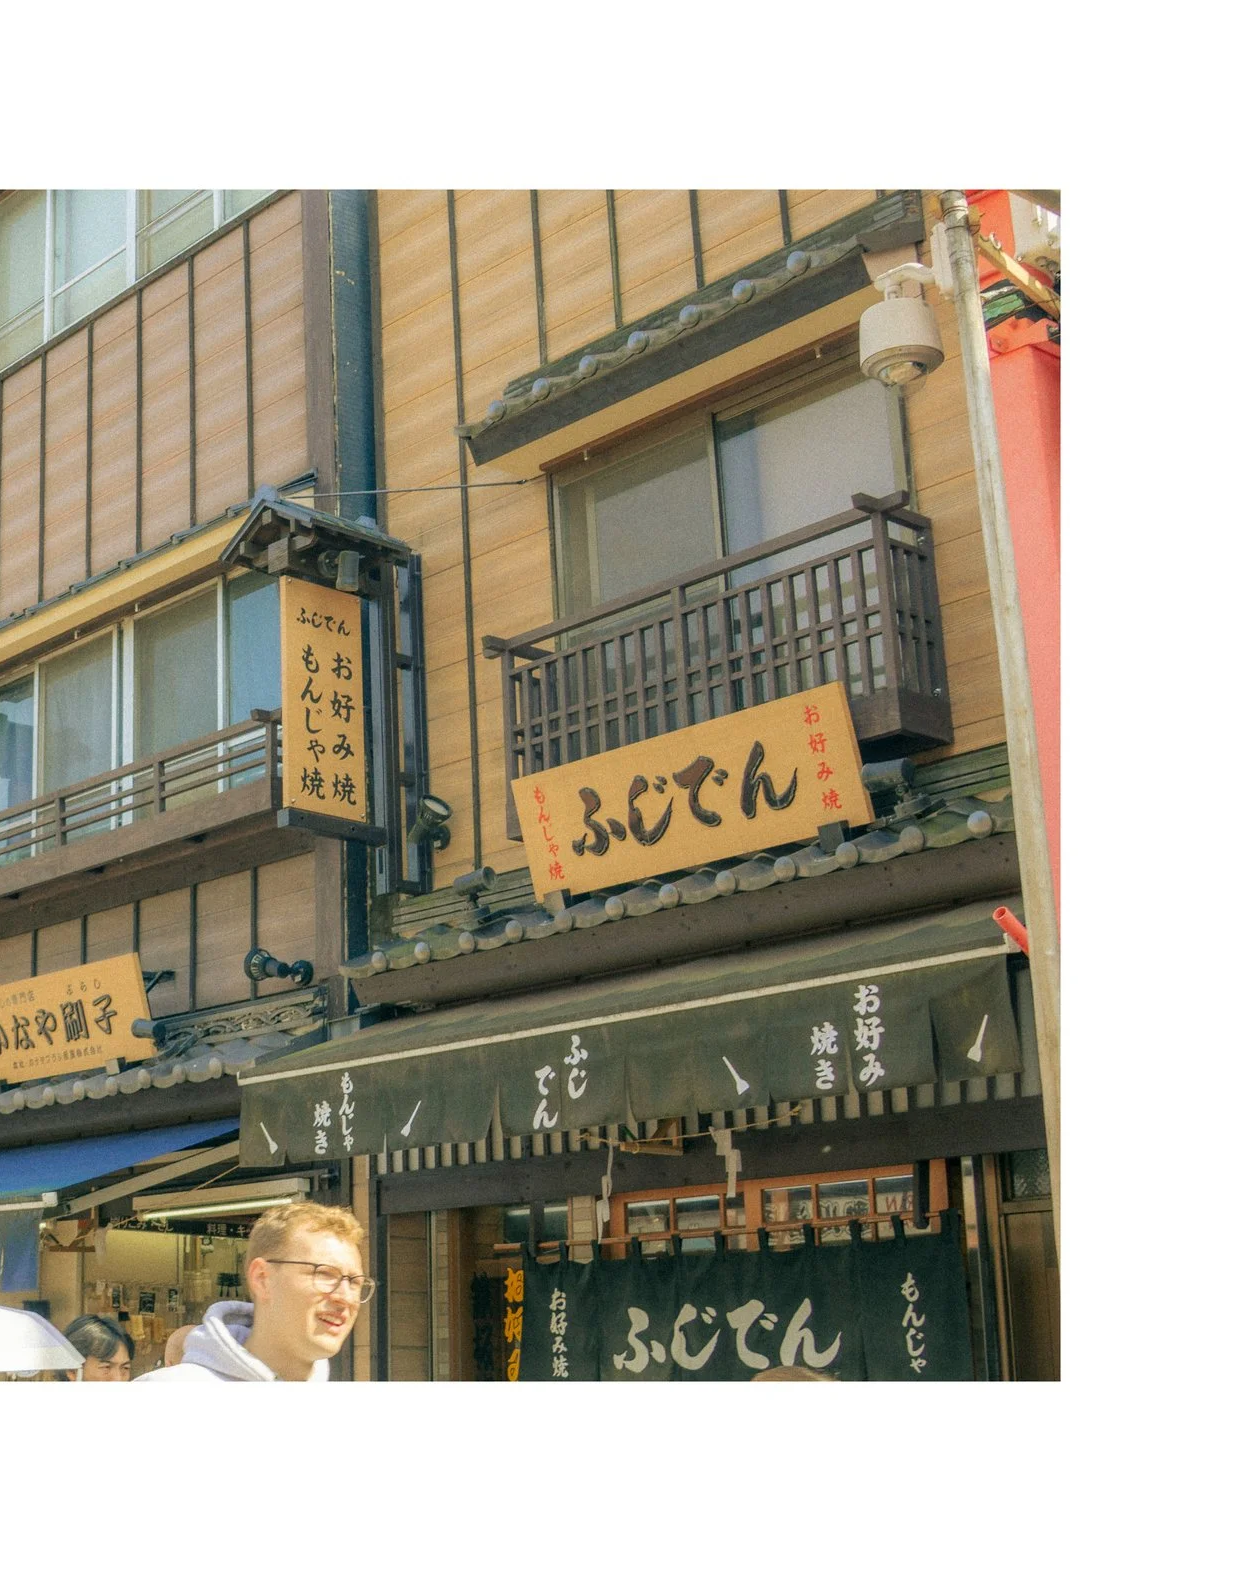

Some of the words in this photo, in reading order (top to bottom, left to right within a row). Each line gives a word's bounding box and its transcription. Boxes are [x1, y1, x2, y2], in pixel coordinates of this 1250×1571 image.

[296, 607, 351, 637] ふじでん
[300, 643, 326, 800] もんじゃ焼
[330, 651, 357, 806] お好み焼
[804, 703, 843, 810] お好み焼
[571, 739, 798, 857] ふじでん
[563, 1034, 589, 1100] ふじ
[810, 1021, 839, 1090] 焼き
[853, 983, 885, 1088] お好み
[313, 1099, 333, 1155] 焼き
[338, 1071, 355, 1153] もんじゃ
[533, 1065, 559, 1130] でん
[549, 1287, 569, 1379] お好み焼
[613, 1297, 842, 1373] ふじでん
[900, 1271, 928, 1374] もんじゃ
